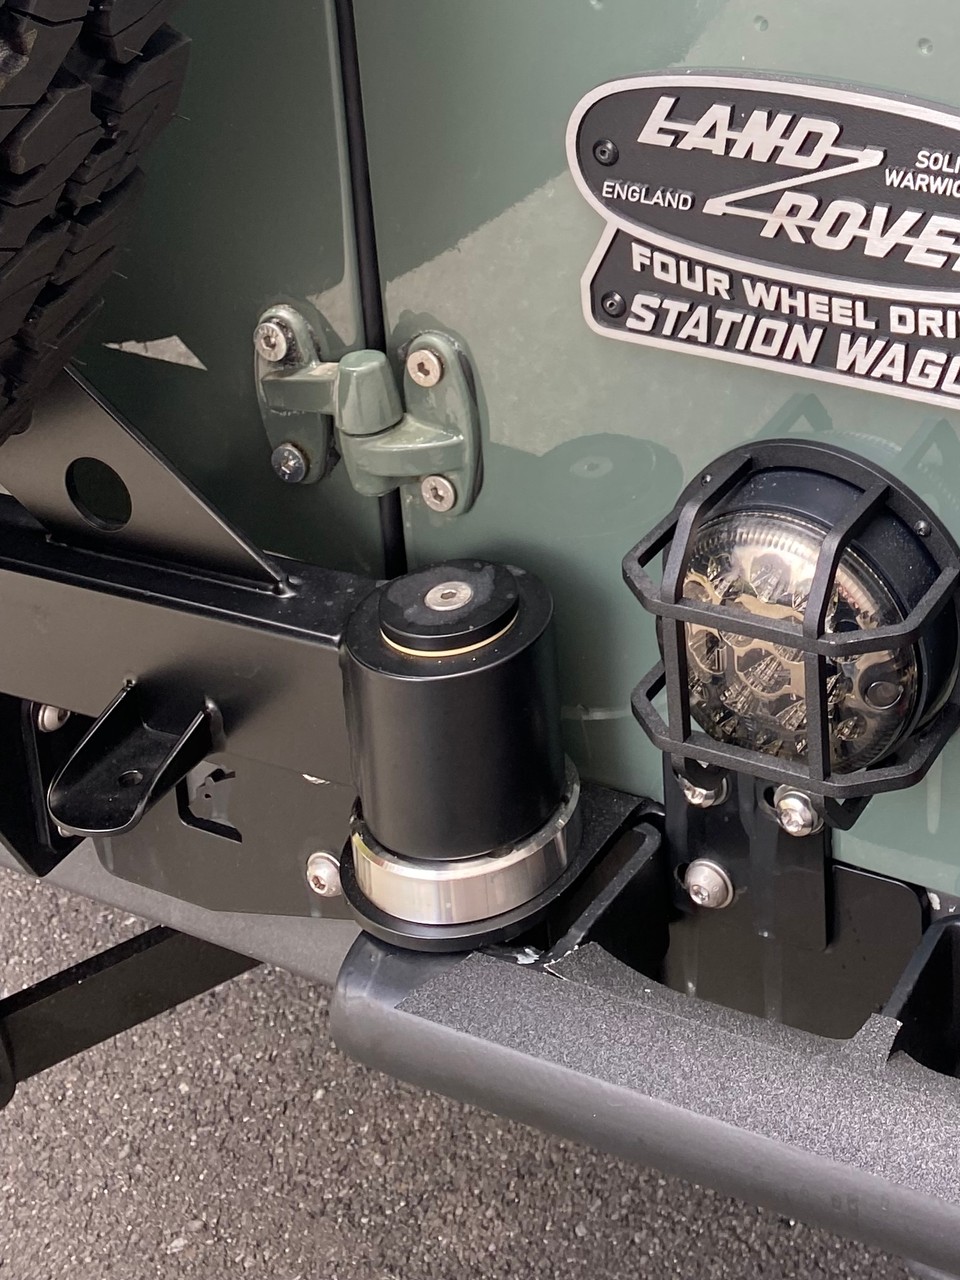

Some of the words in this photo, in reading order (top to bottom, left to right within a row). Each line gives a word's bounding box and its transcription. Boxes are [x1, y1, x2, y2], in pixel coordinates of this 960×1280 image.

[637, 95, 843, 171] LAND
[601, 180, 692, 211] ENGLAND
[631, 240, 731, 301] FOUR
[741, 277, 876, 331] WHEEL
[625, 293, 824, 365] STATION
